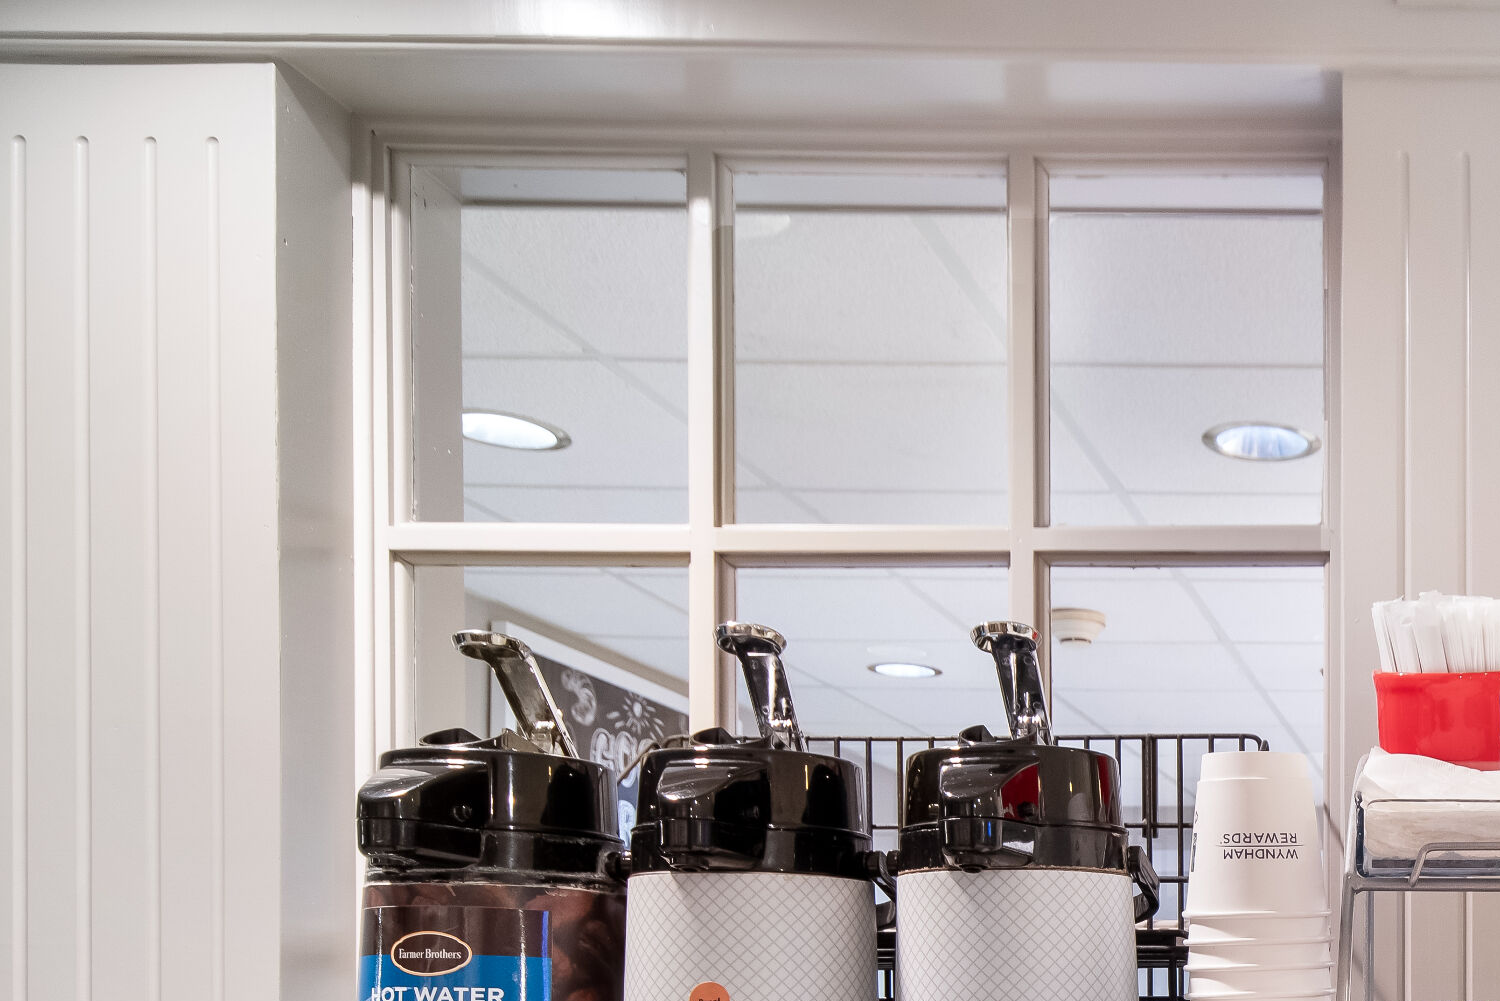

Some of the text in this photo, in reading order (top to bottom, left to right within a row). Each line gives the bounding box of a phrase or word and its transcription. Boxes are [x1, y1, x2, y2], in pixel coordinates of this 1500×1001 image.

[1223, 833, 1297, 844] REWARDS
[1223, 849, 1299, 860] WYNDHAM
[398, 948, 461, 959] Farmer Brothers
